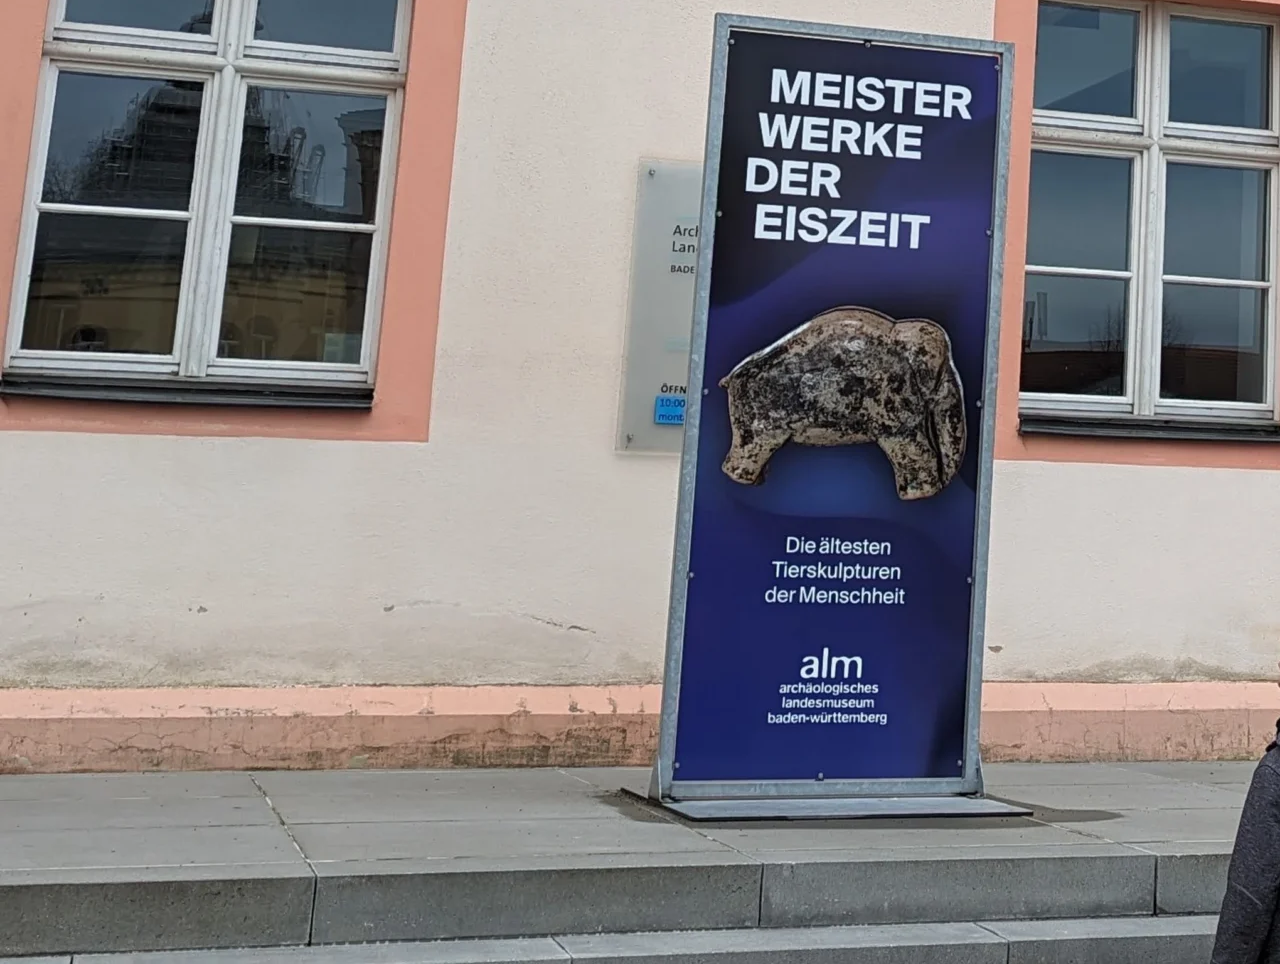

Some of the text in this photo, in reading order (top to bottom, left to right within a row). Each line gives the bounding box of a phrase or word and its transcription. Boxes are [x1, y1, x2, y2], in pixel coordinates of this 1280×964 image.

[771, 68, 972, 120] MEISTER
[759, 113, 923, 160] WERKE
[746, 157, 841, 199] DER
[755, 203, 931, 249] EISZEIT
[672, 240, 698, 253] Lan
[660, 398, 686, 408] 10:00
[786, 536, 891, 555] Die ältesten
[772, 561, 901, 583] Tierskulpturen
[764, 586, 905, 604] der Menschheit
[800, 647, 863, 679] alm
[779, 682, 879, 696] archäologisches
[782, 697, 875, 709] landesmuseum
[767, 712, 888, 726] baden-württemberg
